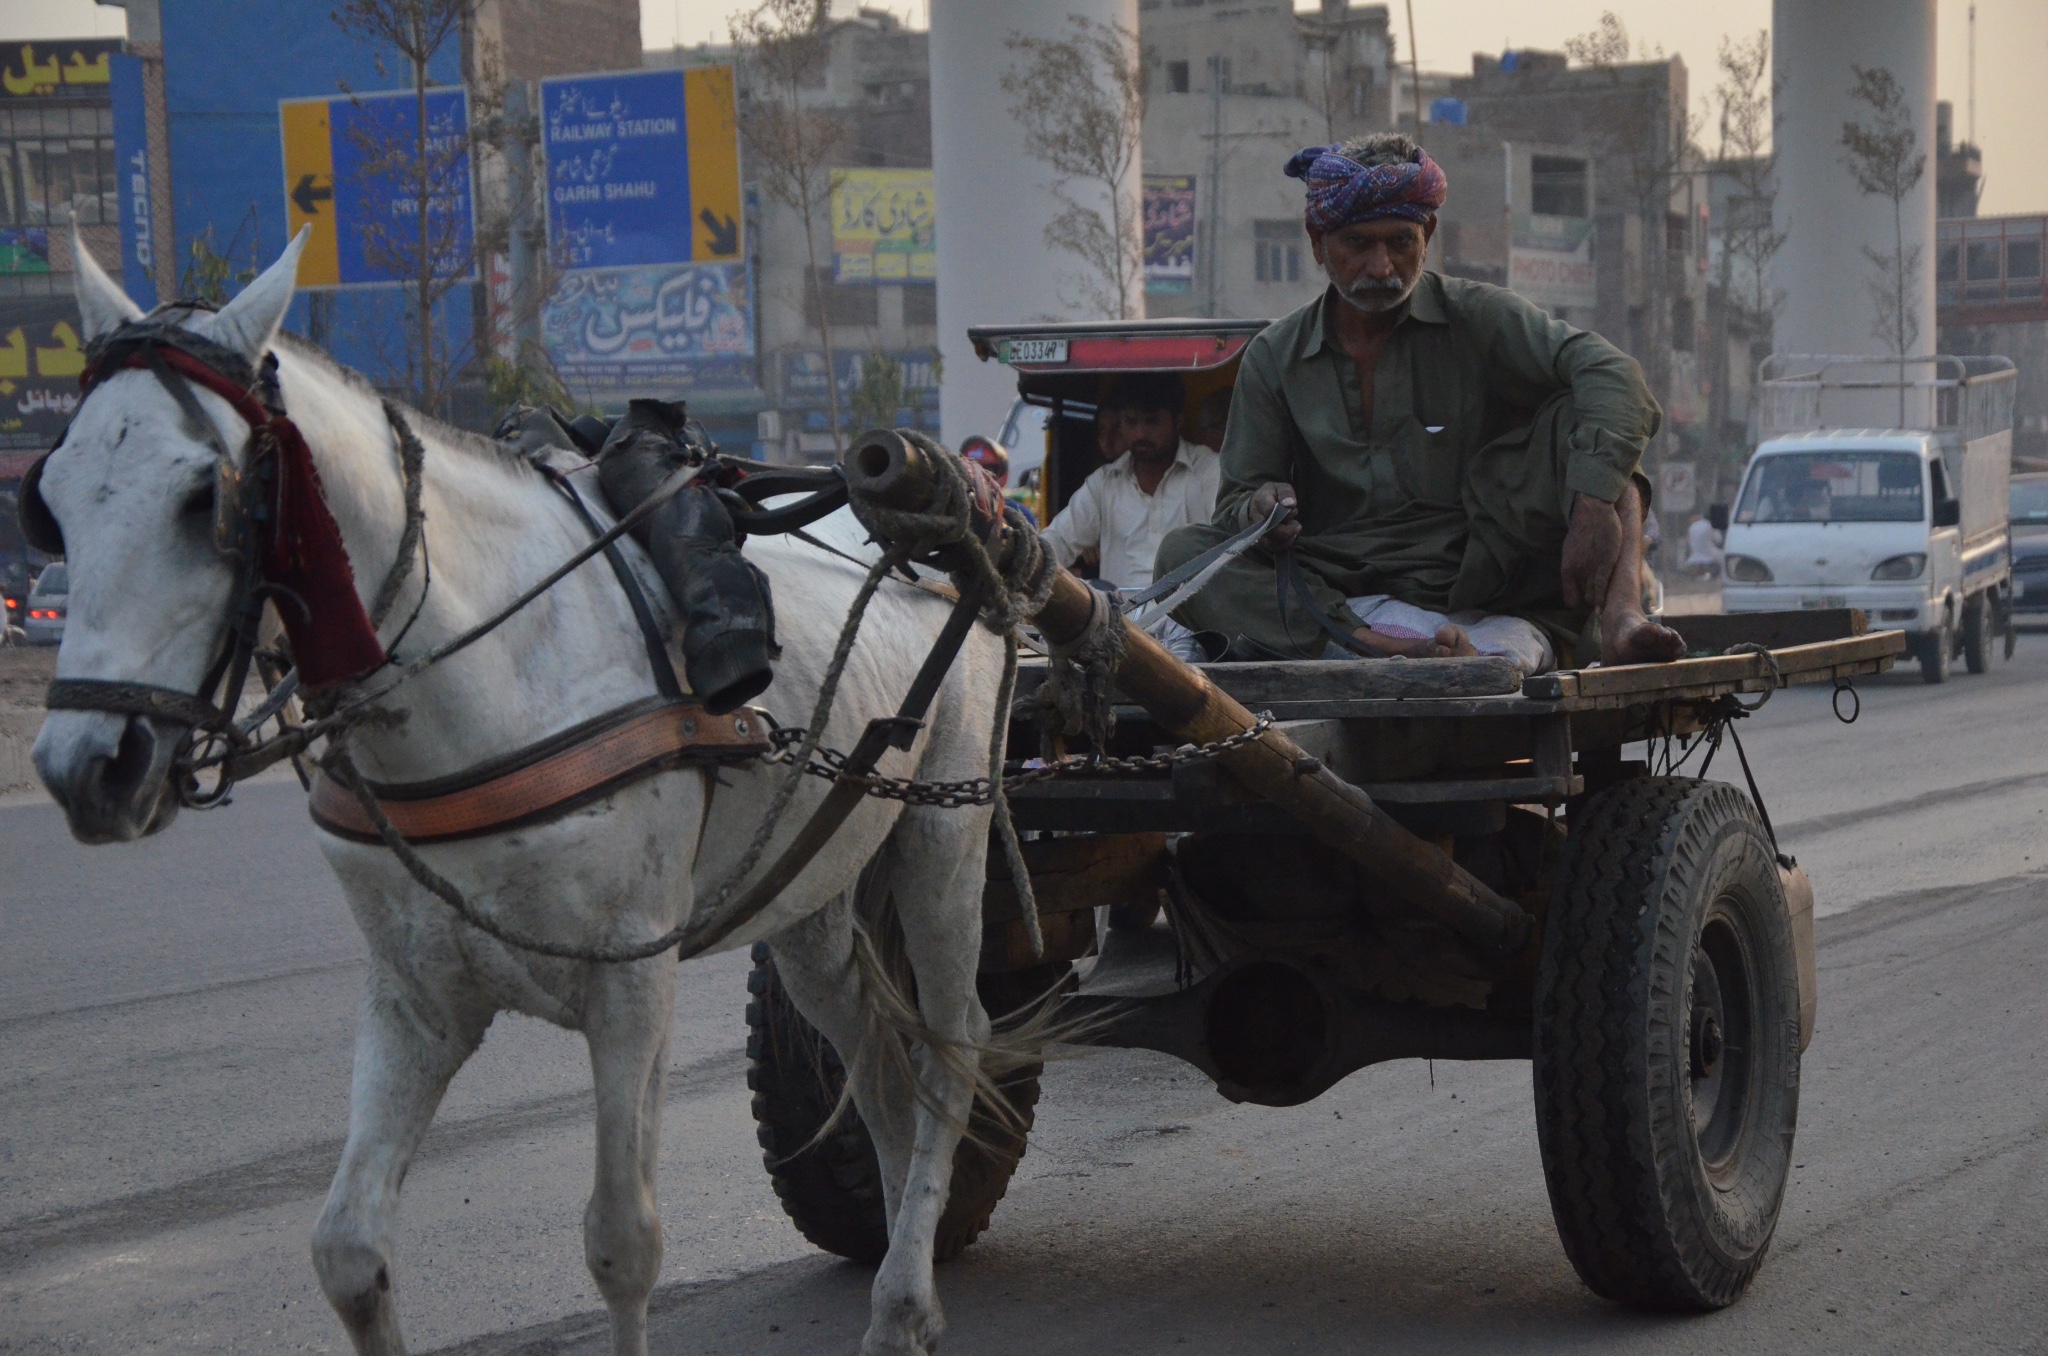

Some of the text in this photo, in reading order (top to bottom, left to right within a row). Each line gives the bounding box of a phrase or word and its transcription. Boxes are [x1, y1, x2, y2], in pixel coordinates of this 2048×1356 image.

[551, 117, 677, 142] RAILWAY STATION
[554, 180, 656, 203] GARHI SHAHU
